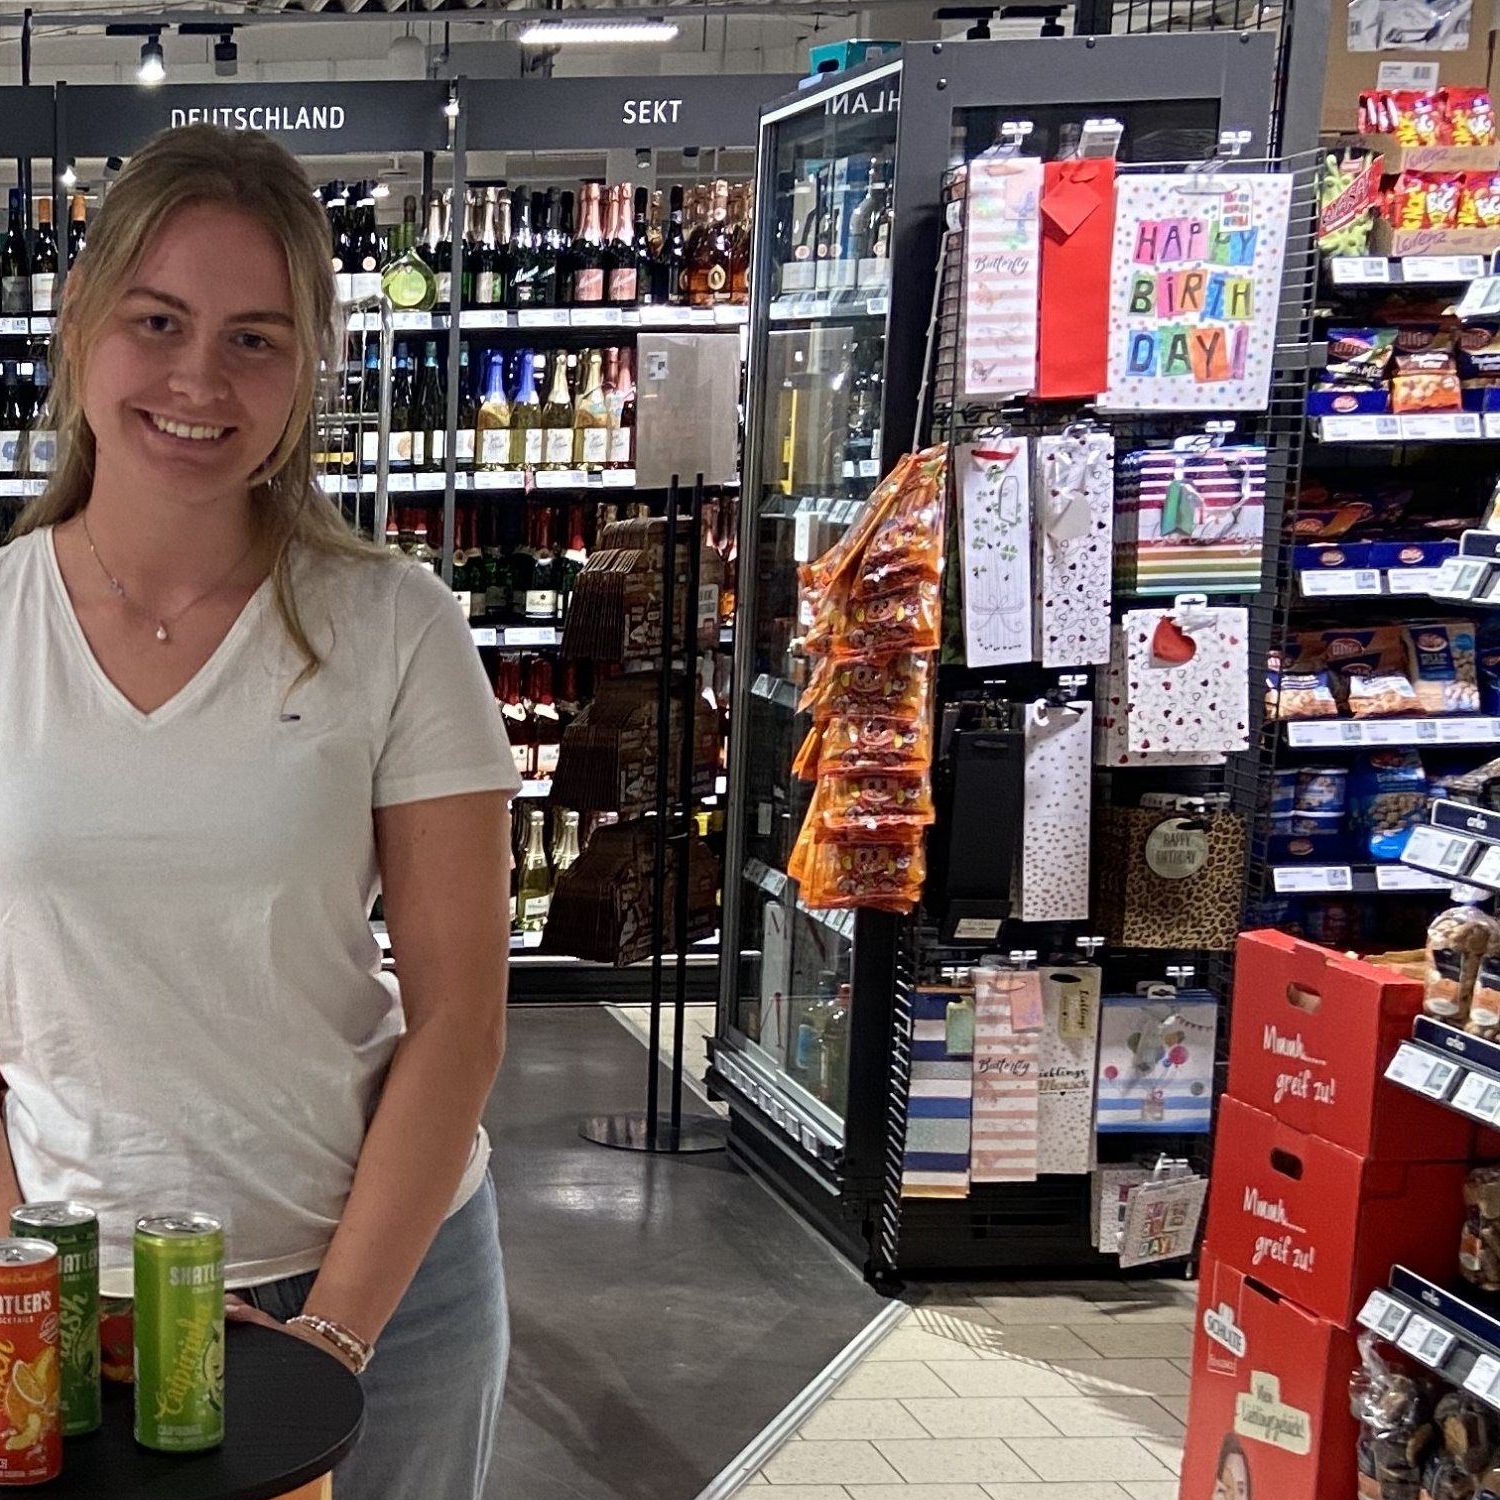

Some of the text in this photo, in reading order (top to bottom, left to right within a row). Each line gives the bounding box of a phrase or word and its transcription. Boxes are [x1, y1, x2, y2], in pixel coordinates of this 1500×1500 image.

[170, 105, 346, 133] DEUTSCHLAND
[622, 99, 683, 126] SEKT
[973, 255, 1030, 275] Butterfly
[1129, 330, 1249, 380] DAY!
[979, 1057, 1031, 1077] Butterfly
[1313, 1078, 1337, 1105] zu!
[1293, 1246, 1316, 1274] zu!
[1207, 1314, 1242, 1353] SCHULTE
